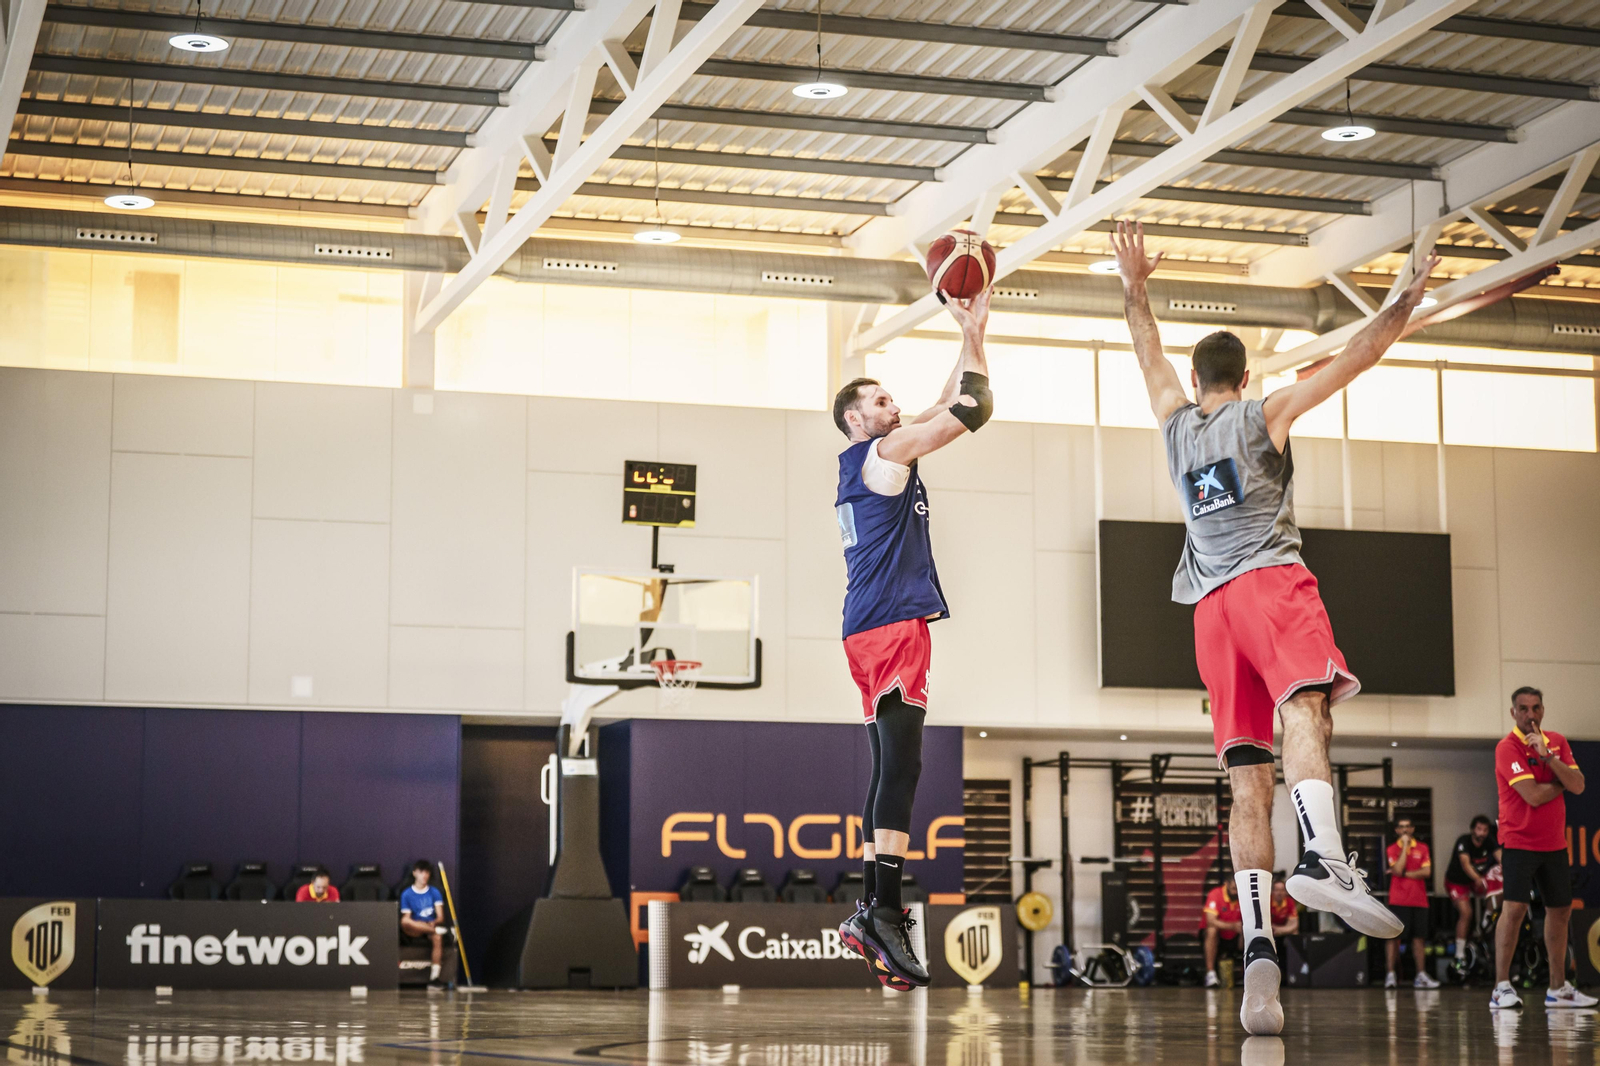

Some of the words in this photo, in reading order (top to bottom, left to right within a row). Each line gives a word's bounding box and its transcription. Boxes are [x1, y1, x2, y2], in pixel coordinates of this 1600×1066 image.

[1192, 495, 1235, 516] CaixaBank
[51, 906, 71, 916] FEB
[126, 924, 370, 966] finetwork
[738, 926, 866, 960] CaixaBa
